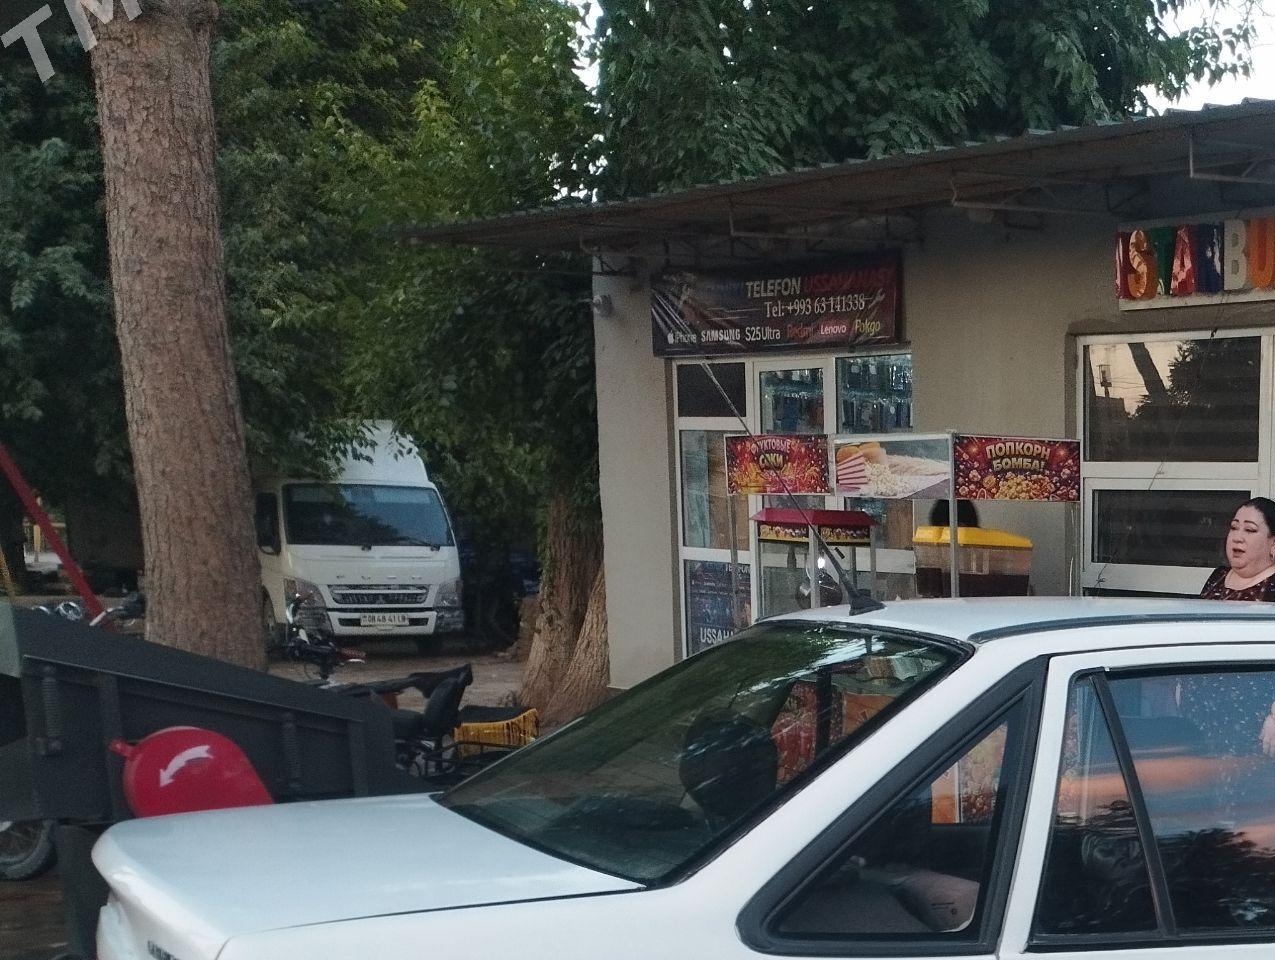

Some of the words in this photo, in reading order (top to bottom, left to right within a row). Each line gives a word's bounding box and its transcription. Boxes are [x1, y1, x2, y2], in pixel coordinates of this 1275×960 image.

[745, 278, 801, 298] TELEFON
[764, 301, 785, 318] Tel:
[787, 298, 812, 316] +993
[814, 297, 826, 313] 63
[701, 329, 741, 342] SAMSUNG
[820, 325, 847, 335] Lenovo
[985, 442, 1050, 460] ПОПКОРН
